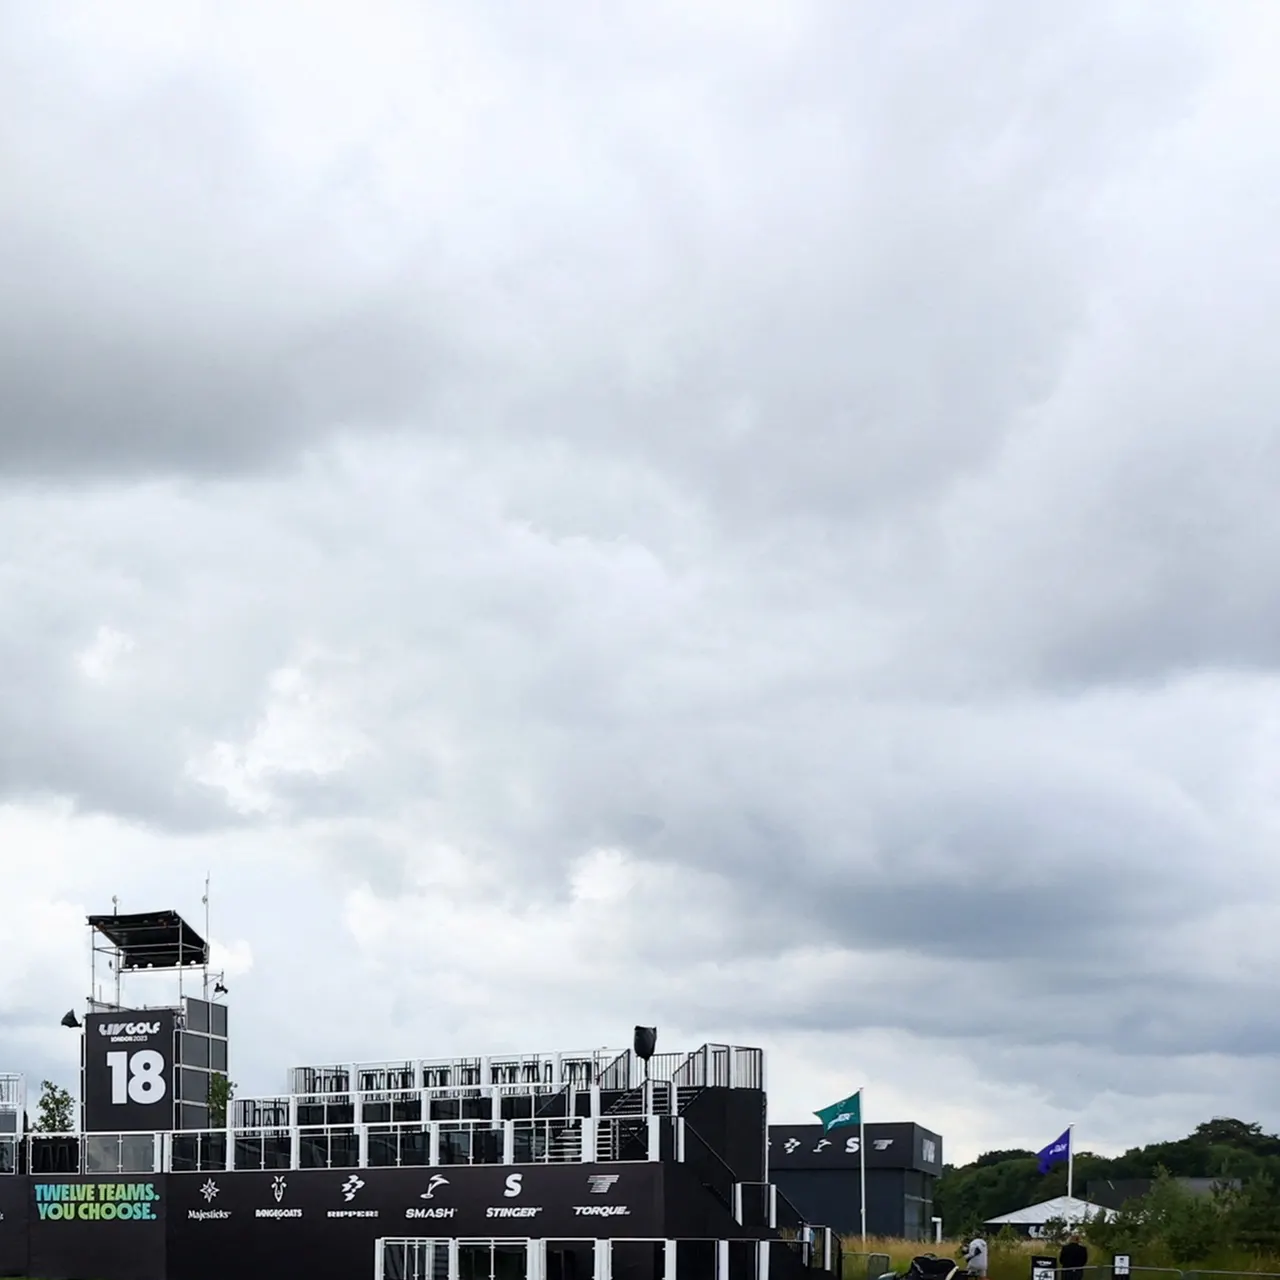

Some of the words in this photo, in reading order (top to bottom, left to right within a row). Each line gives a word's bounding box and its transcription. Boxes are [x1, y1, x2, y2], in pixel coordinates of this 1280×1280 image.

[125, 1021, 161, 1035] GOLF
[106, 1049, 166, 1105] 18
[34, 1184, 95, 1202] TWELVE
[97, 1183, 161, 1201] TEAMS.
[37, 1203, 75, 1220] YOU
[78, 1202, 158, 1220] CHOOSE.
[187, 1209, 229, 1221] Majesticks
[327, 1210, 374, 1218] RIPPER
[405, 1207, 455, 1219] SMASH
[486, 1207, 537, 1218] STINGER
[572, 1206, 628, 1217] TORQUE
